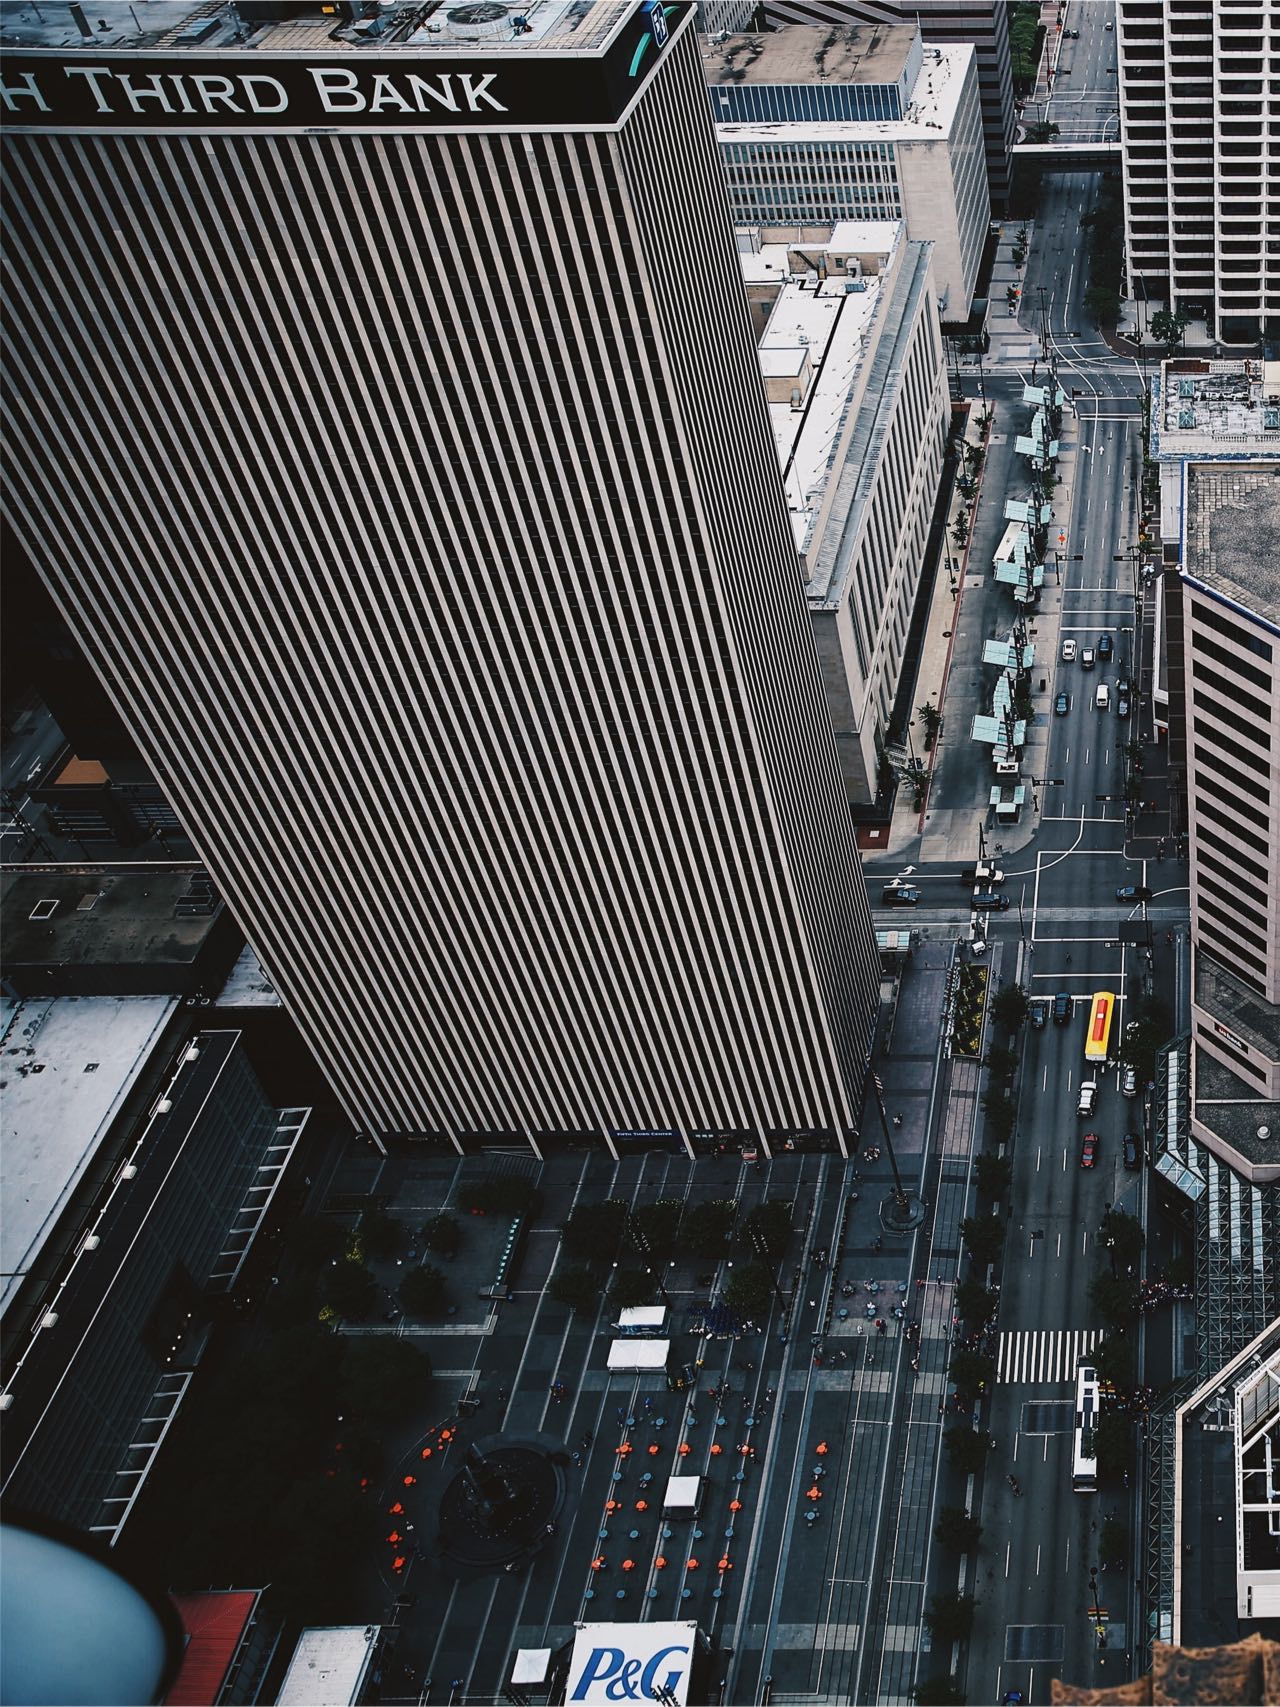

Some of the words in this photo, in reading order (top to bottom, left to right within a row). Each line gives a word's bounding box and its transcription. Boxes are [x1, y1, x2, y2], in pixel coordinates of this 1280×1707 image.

[63, 66, 289, 114] THIRD
[306, 68, 509, 113] BANK
[570, 1646, 690, 1701] P&G
